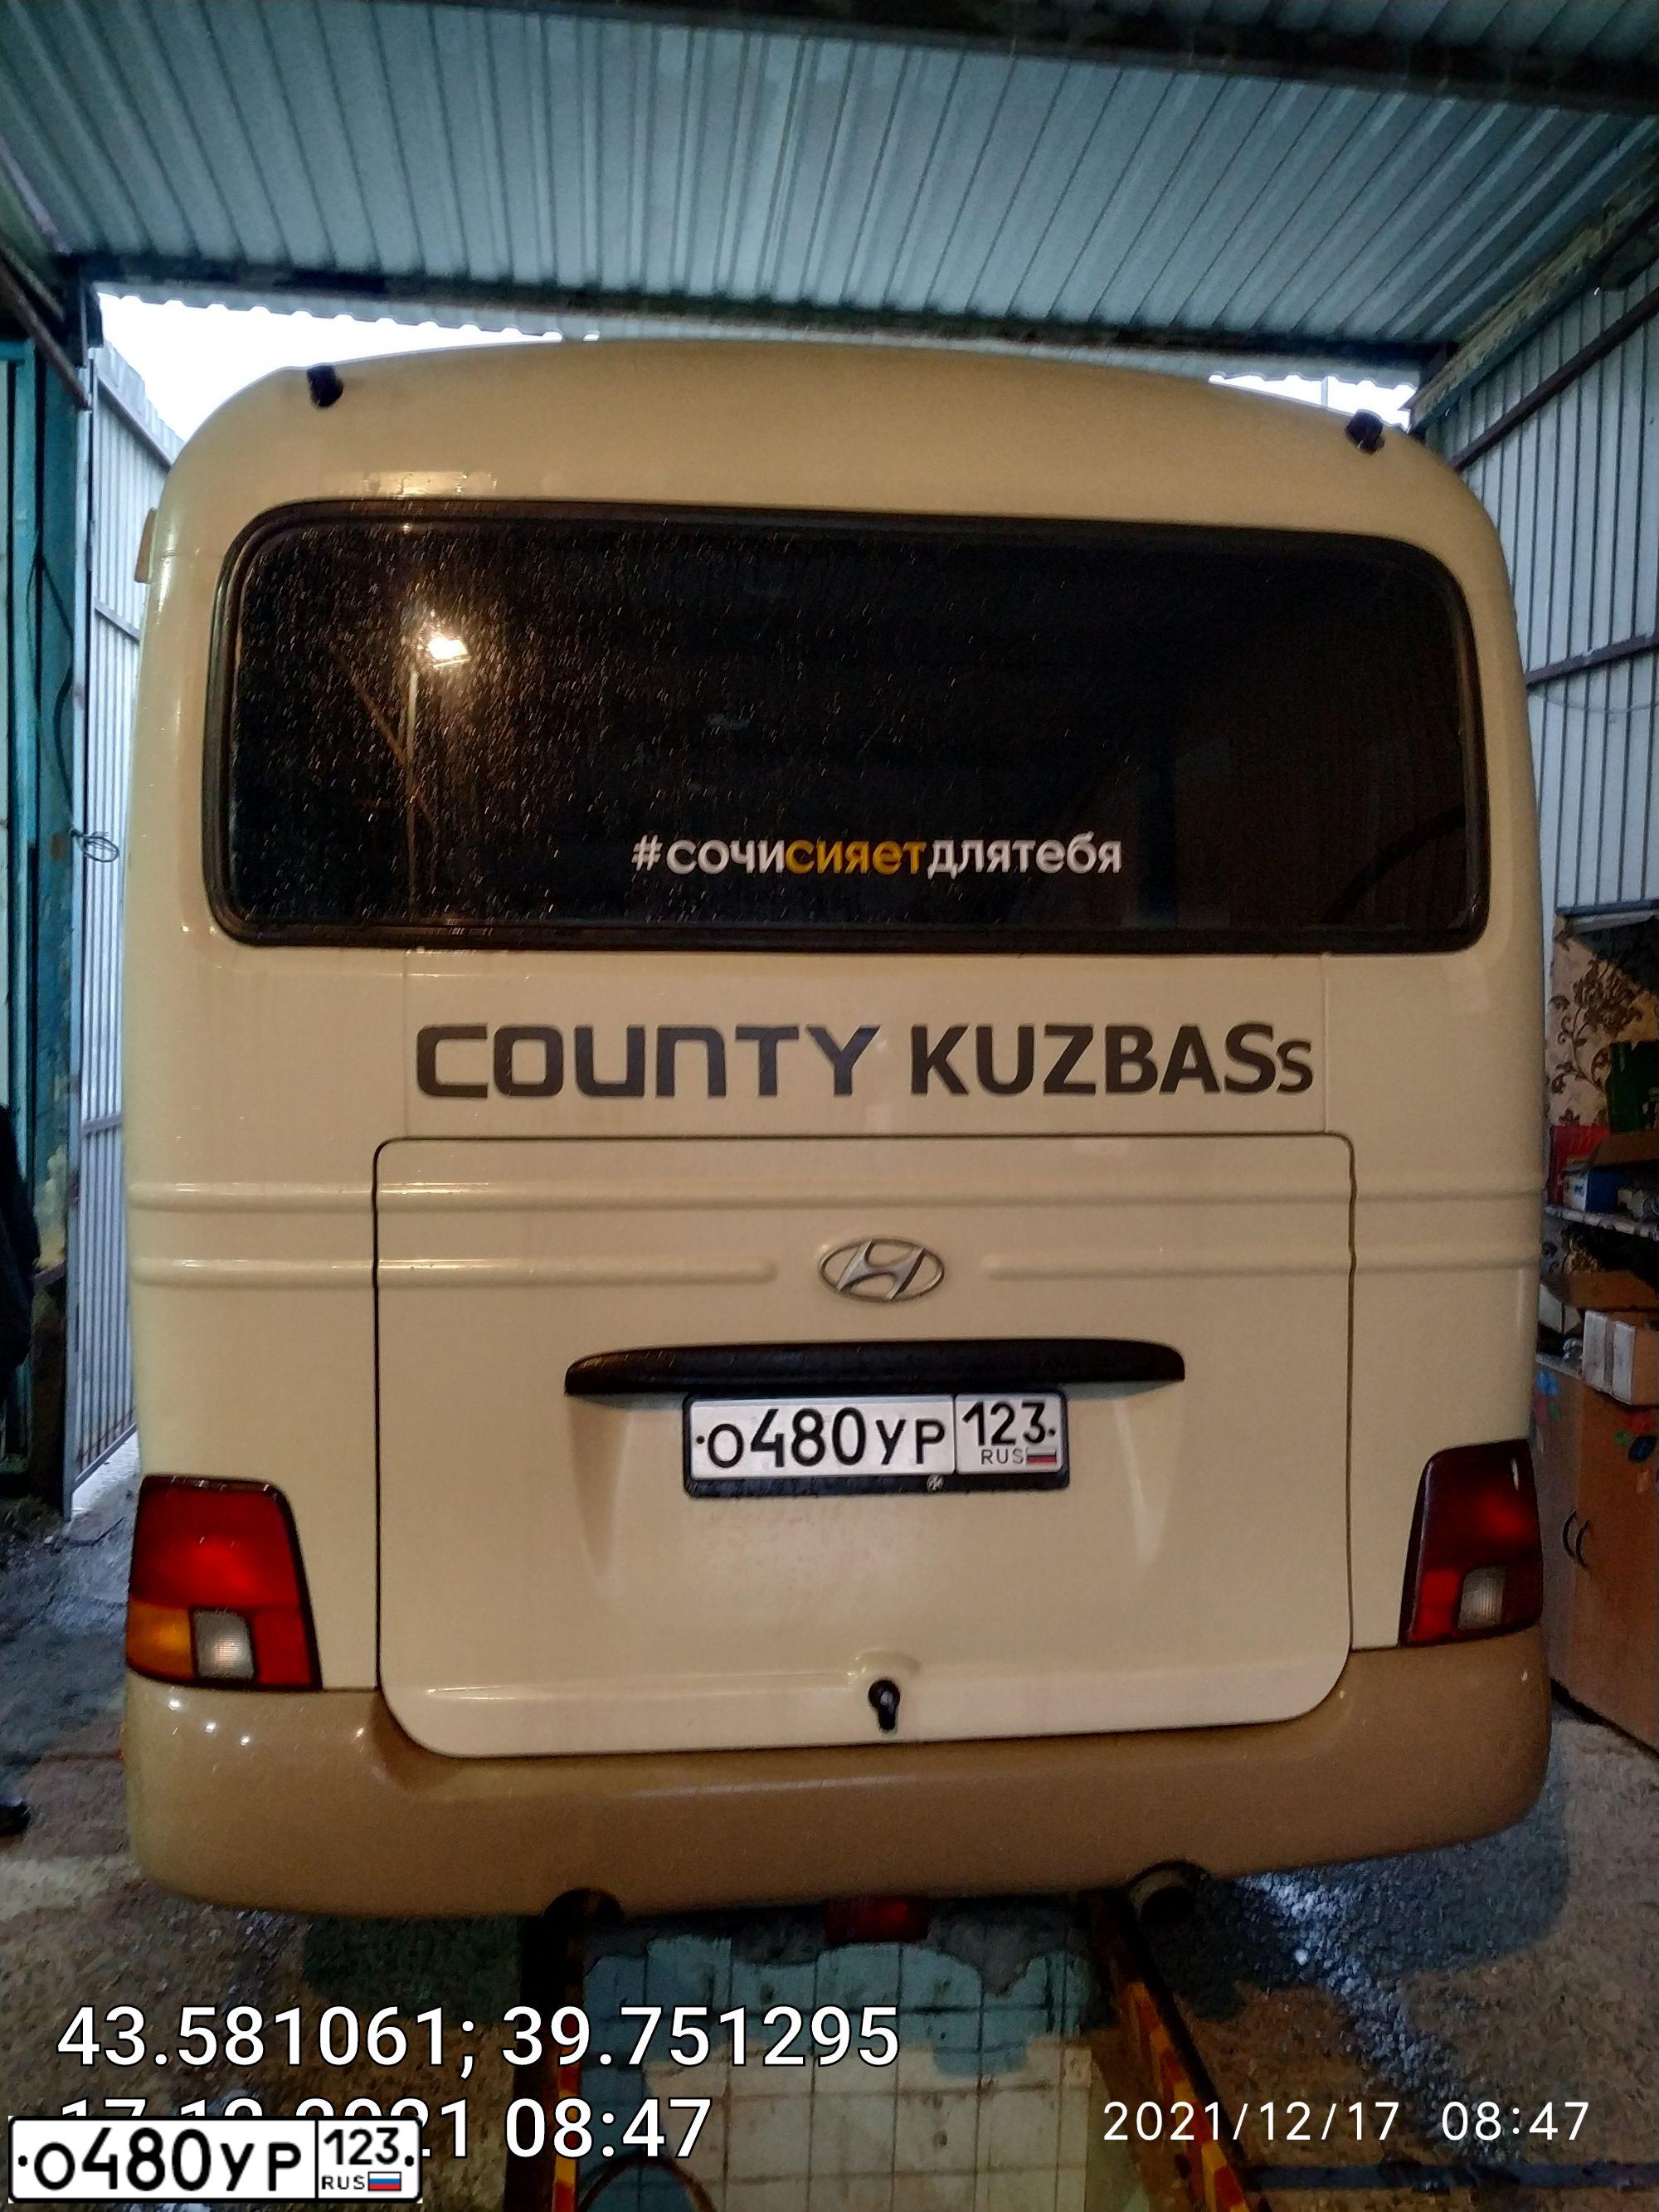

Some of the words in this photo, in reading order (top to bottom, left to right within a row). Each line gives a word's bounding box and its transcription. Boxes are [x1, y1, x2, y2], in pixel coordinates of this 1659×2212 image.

[416, 1025, 881, 1099] COUNTY
[961, 1401, 1047, 1446] 123
[980, 1448, 1024, 1466] RUS
